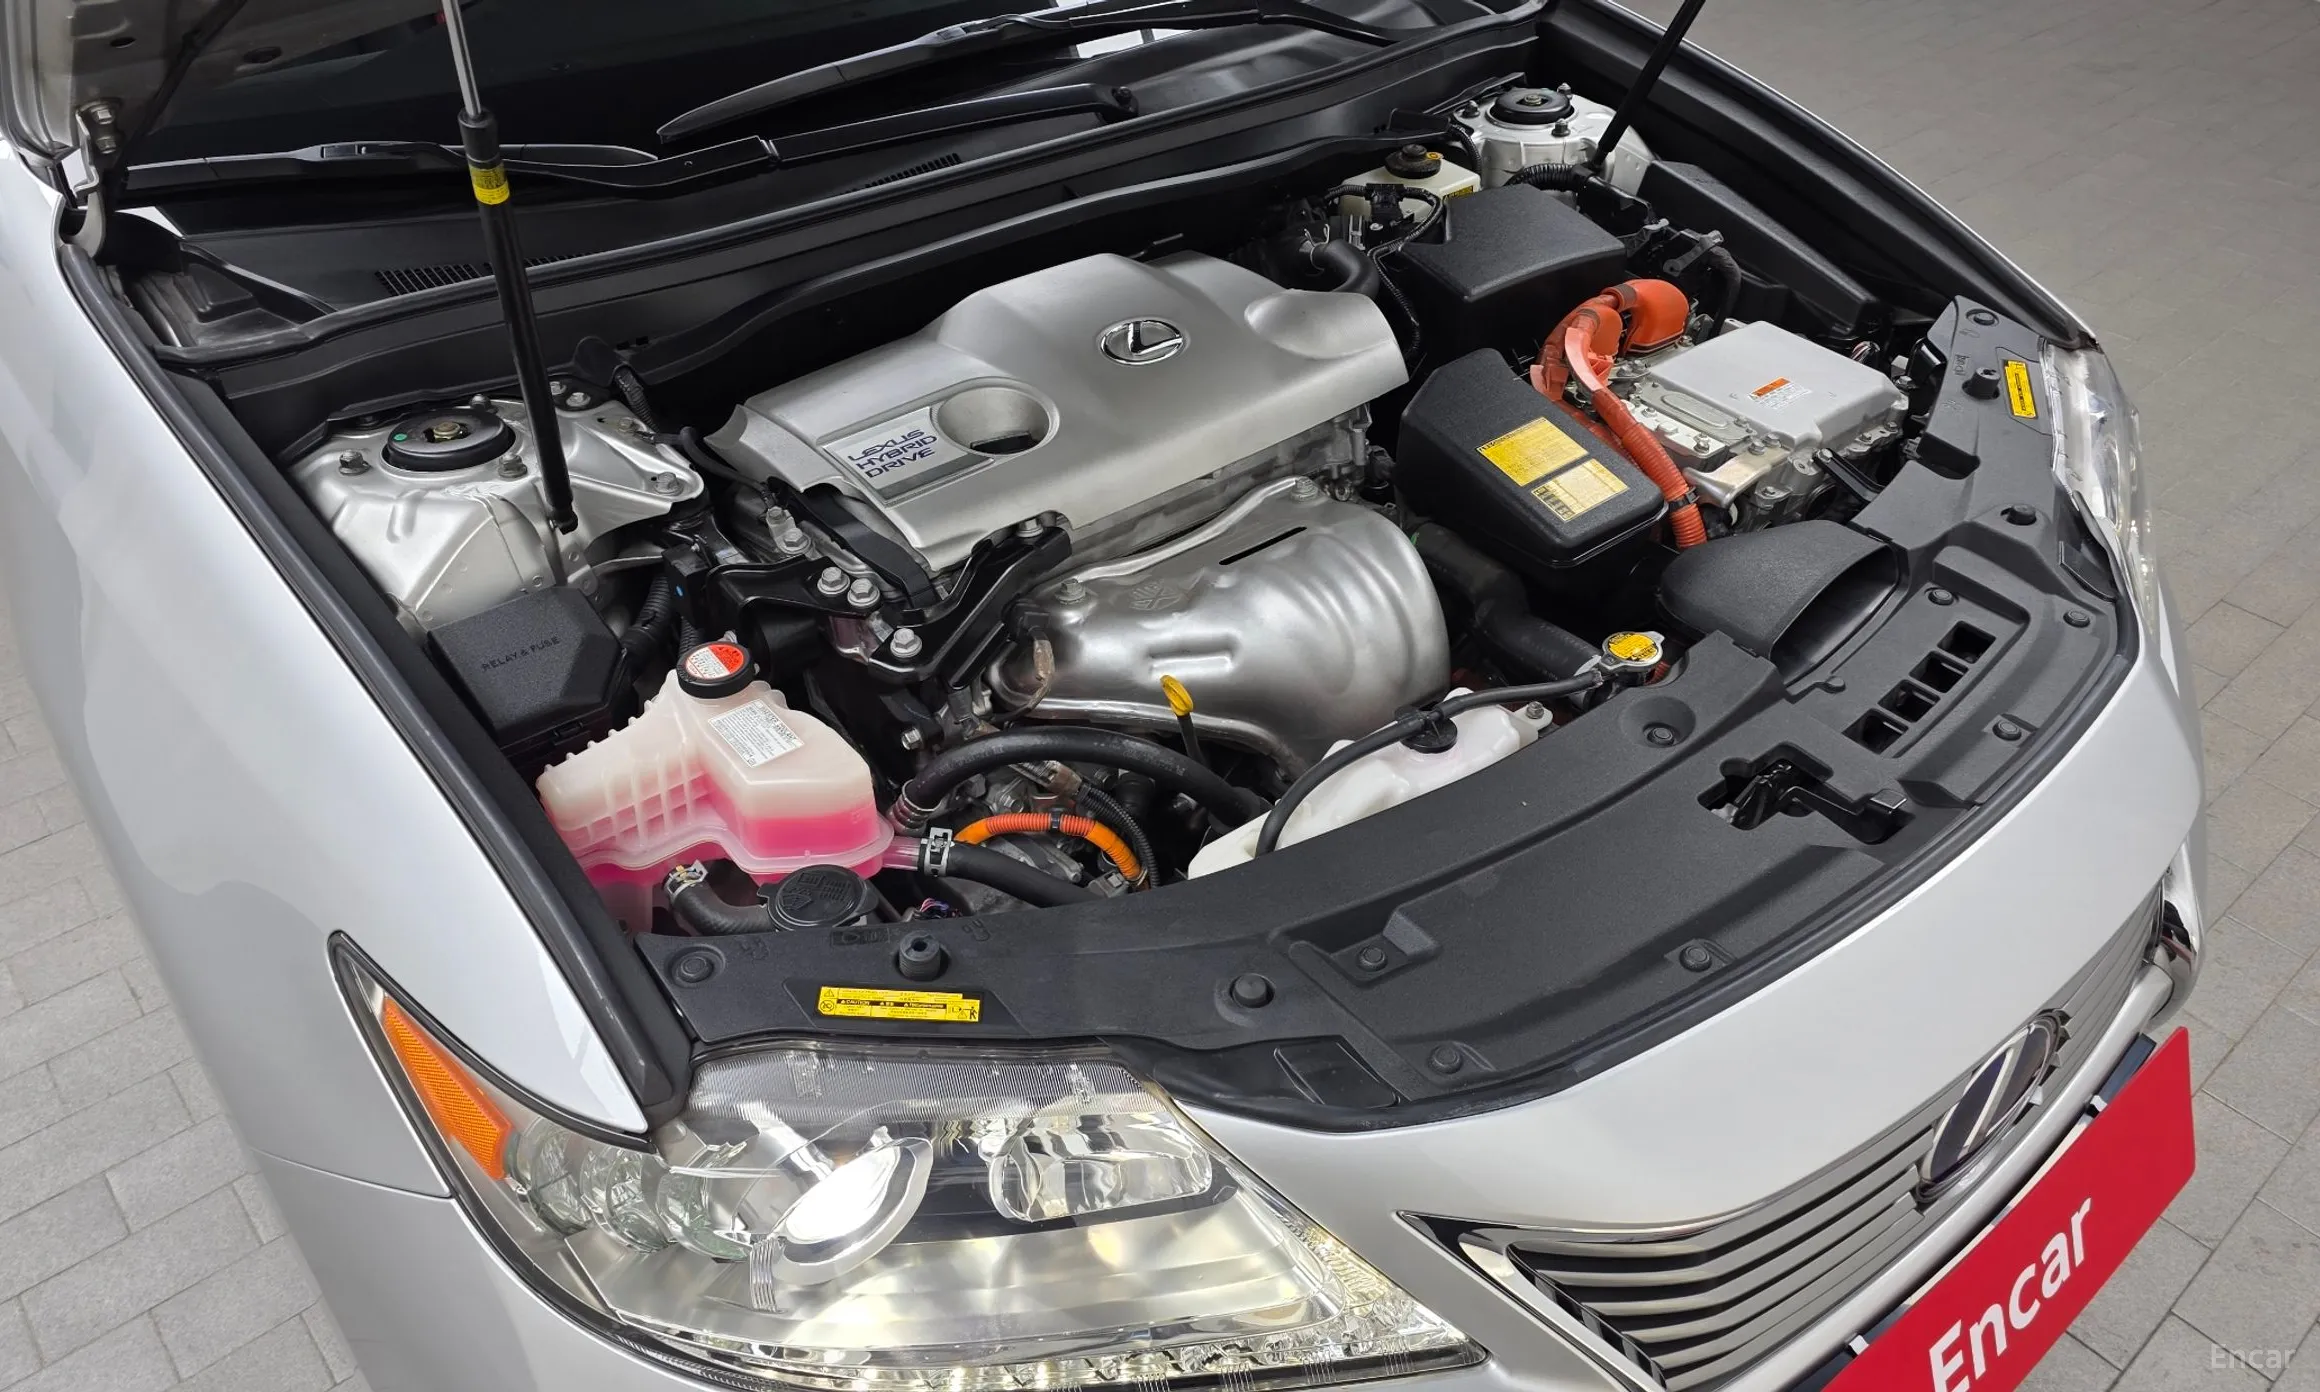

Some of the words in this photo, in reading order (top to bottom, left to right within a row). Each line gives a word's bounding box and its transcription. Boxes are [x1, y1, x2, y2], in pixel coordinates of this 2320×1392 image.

[847, 429, 925, 461] LEXUS
[855, 435, 938, 470] HYBRID
[865, 447, 936, 478] DRIVE
[481, 651, 518, 673] RELAY
[529, 636, 560, 653] FUSE
[1928, 1196, 2092, 1392] Encar
